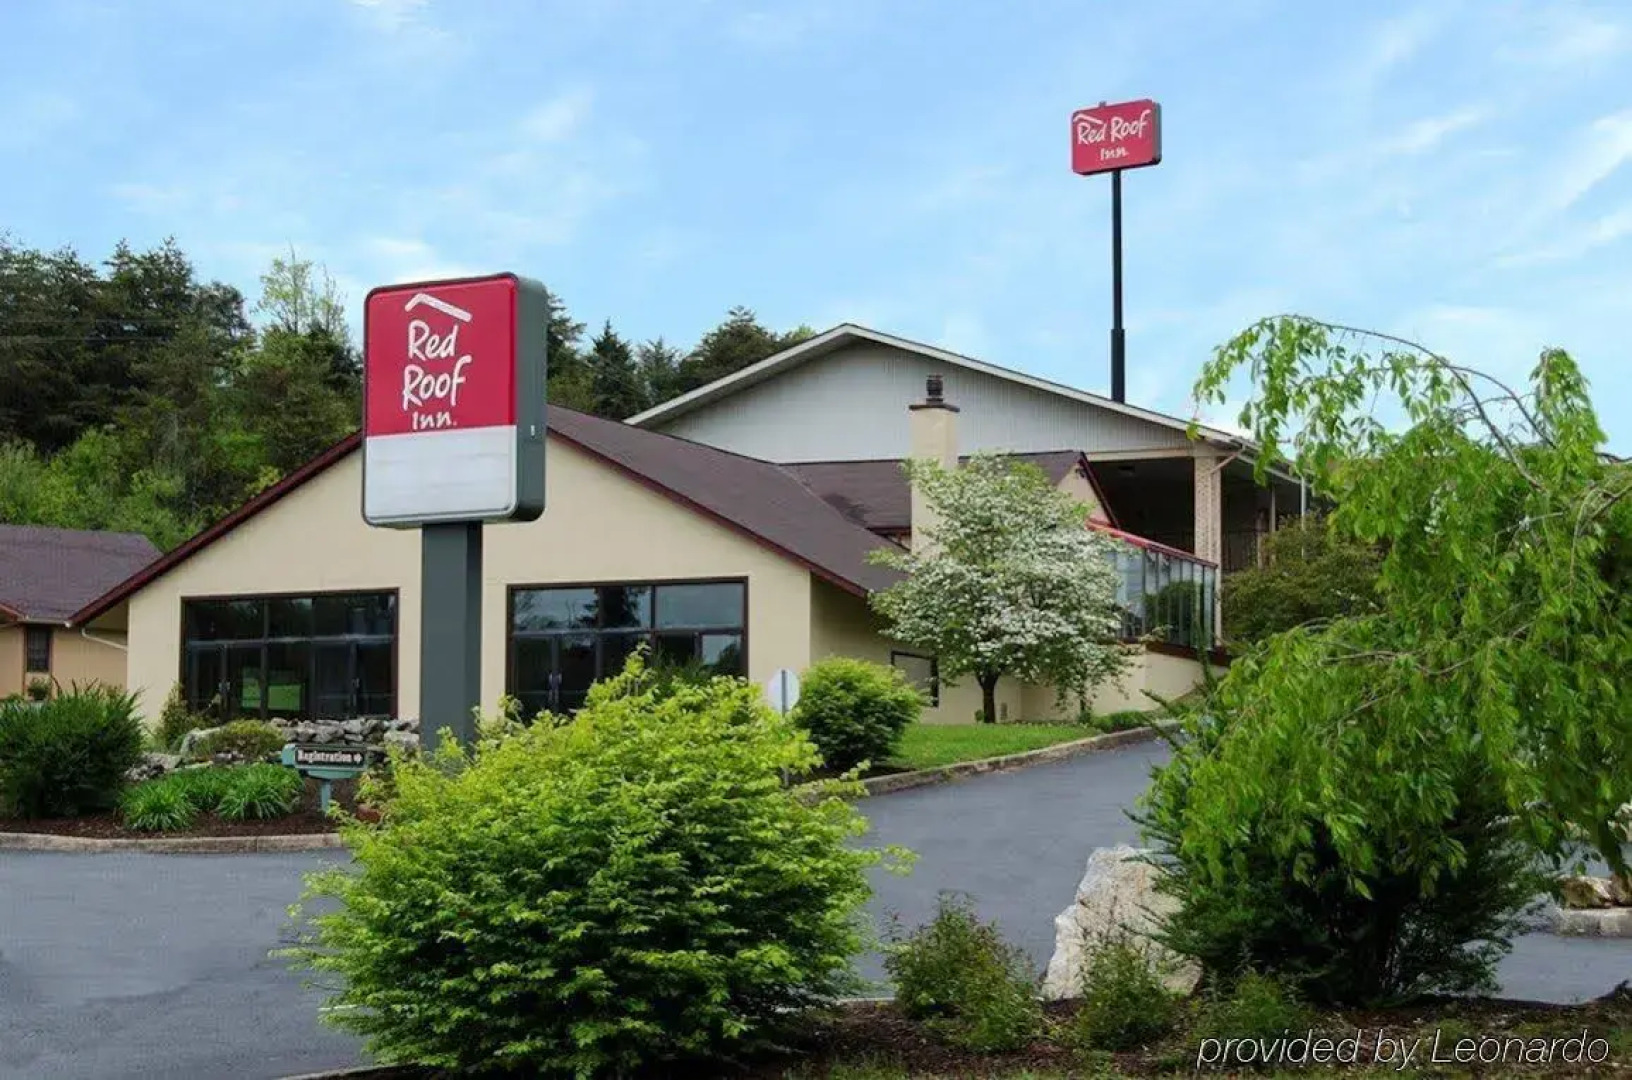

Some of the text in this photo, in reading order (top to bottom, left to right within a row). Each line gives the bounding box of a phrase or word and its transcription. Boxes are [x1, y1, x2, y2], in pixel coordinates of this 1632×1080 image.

[1078, 109, 1151, 145] Red Roof
[408, 319, 458, 361] Red
[402, 354, 472, 411] Roof
[298, 749, 352, 764] Registration
